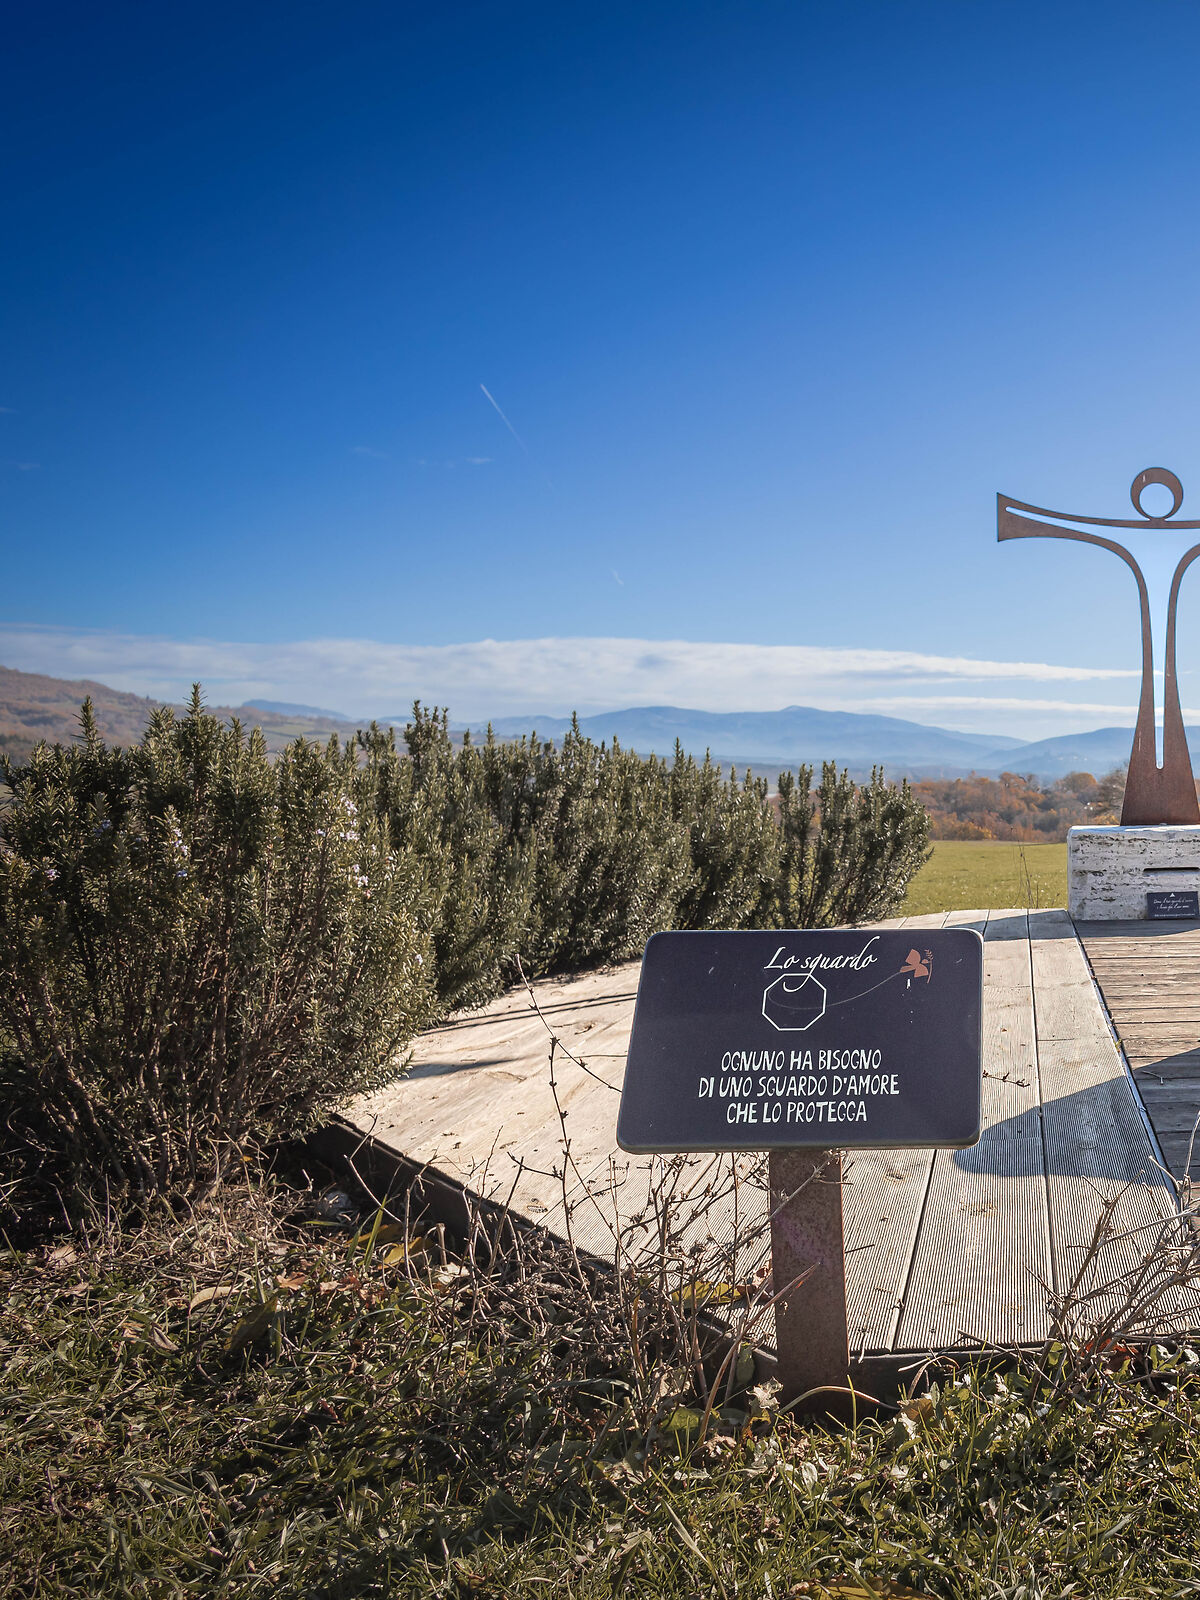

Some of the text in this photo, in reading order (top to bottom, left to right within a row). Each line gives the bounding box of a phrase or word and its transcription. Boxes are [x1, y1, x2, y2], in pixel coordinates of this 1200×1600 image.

[763, 936, 881, 993] Lo sguardo
[721, 1049, 882, 1072] OGNUNO HA BISOGNO
[698, 1074, 900, 1098] DI UNO SGUARDO D'AMORE
[726, 1101, 867, 1124] CHE LO PROTEGGA
